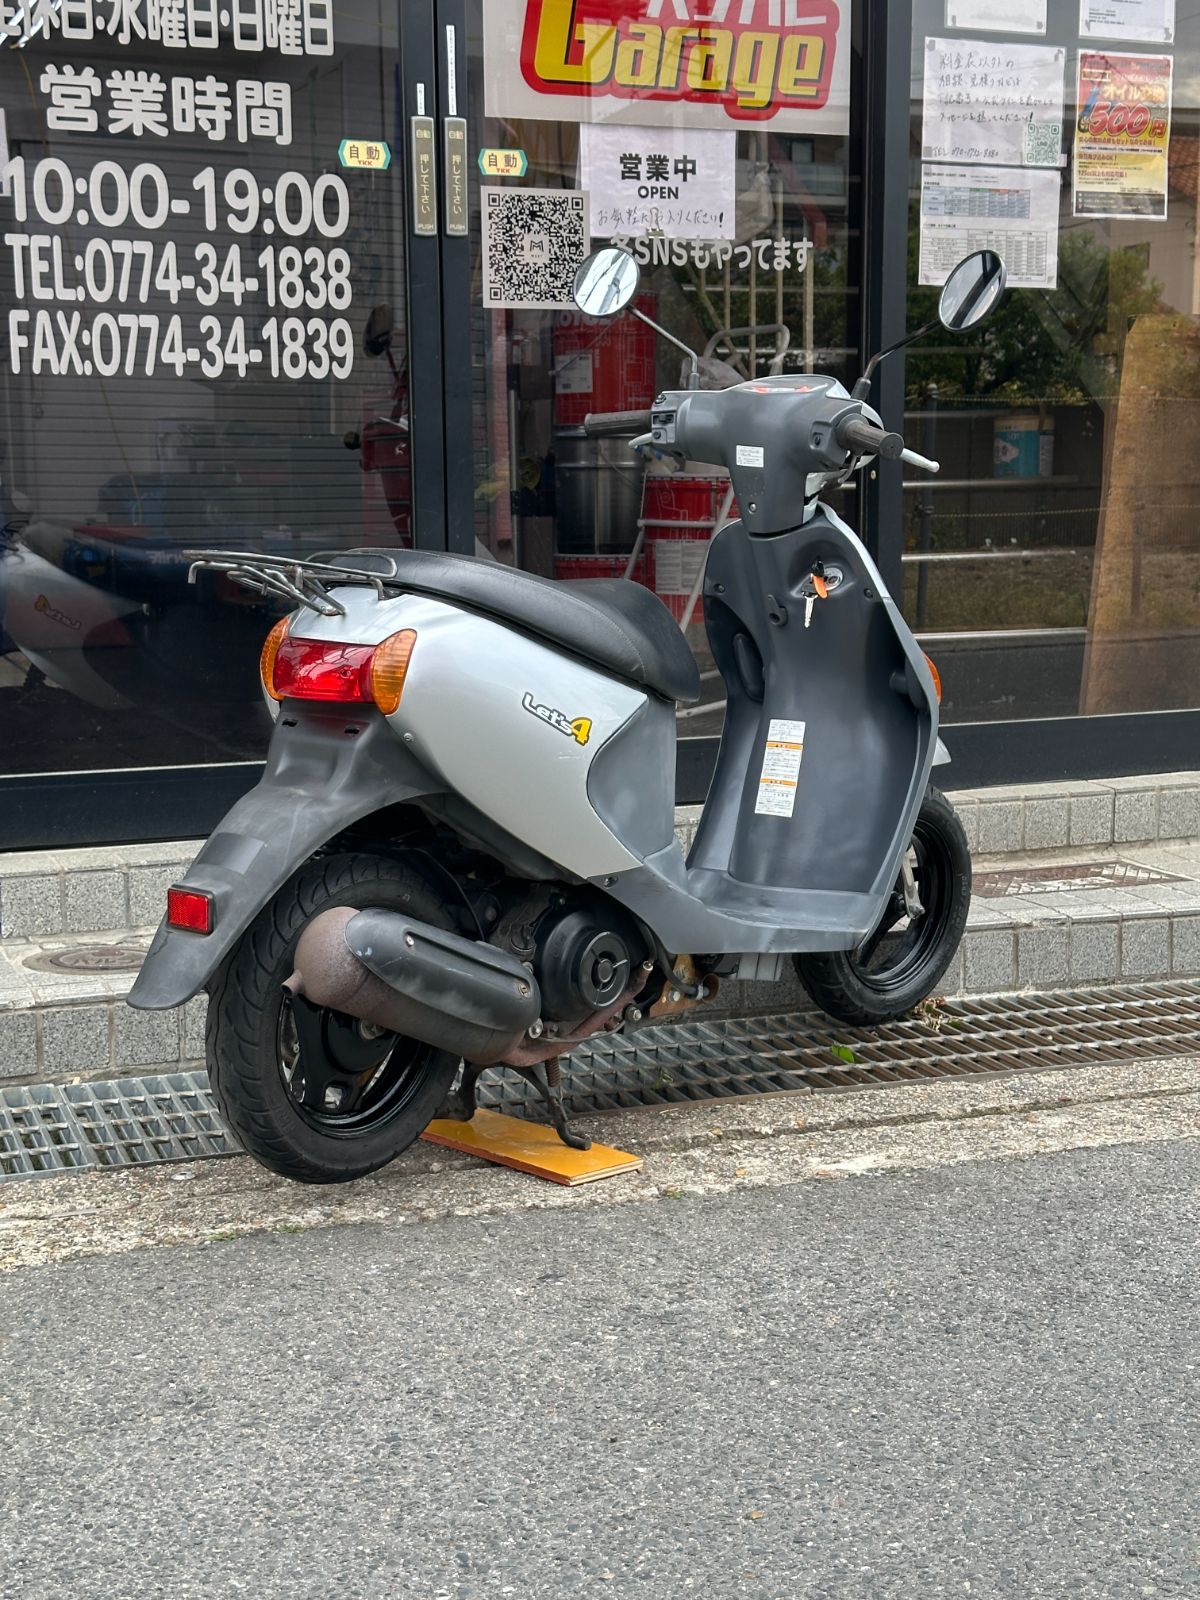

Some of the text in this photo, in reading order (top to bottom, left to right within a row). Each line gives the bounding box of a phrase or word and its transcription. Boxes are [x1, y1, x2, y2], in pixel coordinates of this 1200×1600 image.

[0, 0, 335, 56] 休日:水曜日・日曜日
[533, 0, 826, 110] Garage
[40, 64, 292, 145] 営業時間
[5, 155, 350, 238] 10:00-19:00
[619, 152, 697, 182] 営業中
[637, 185, 679, 200] OPEN
[4, 233, 353, 311] TEL:0774-34-1838
[8, 309, 354, 380] FAX:0774-34-1839
